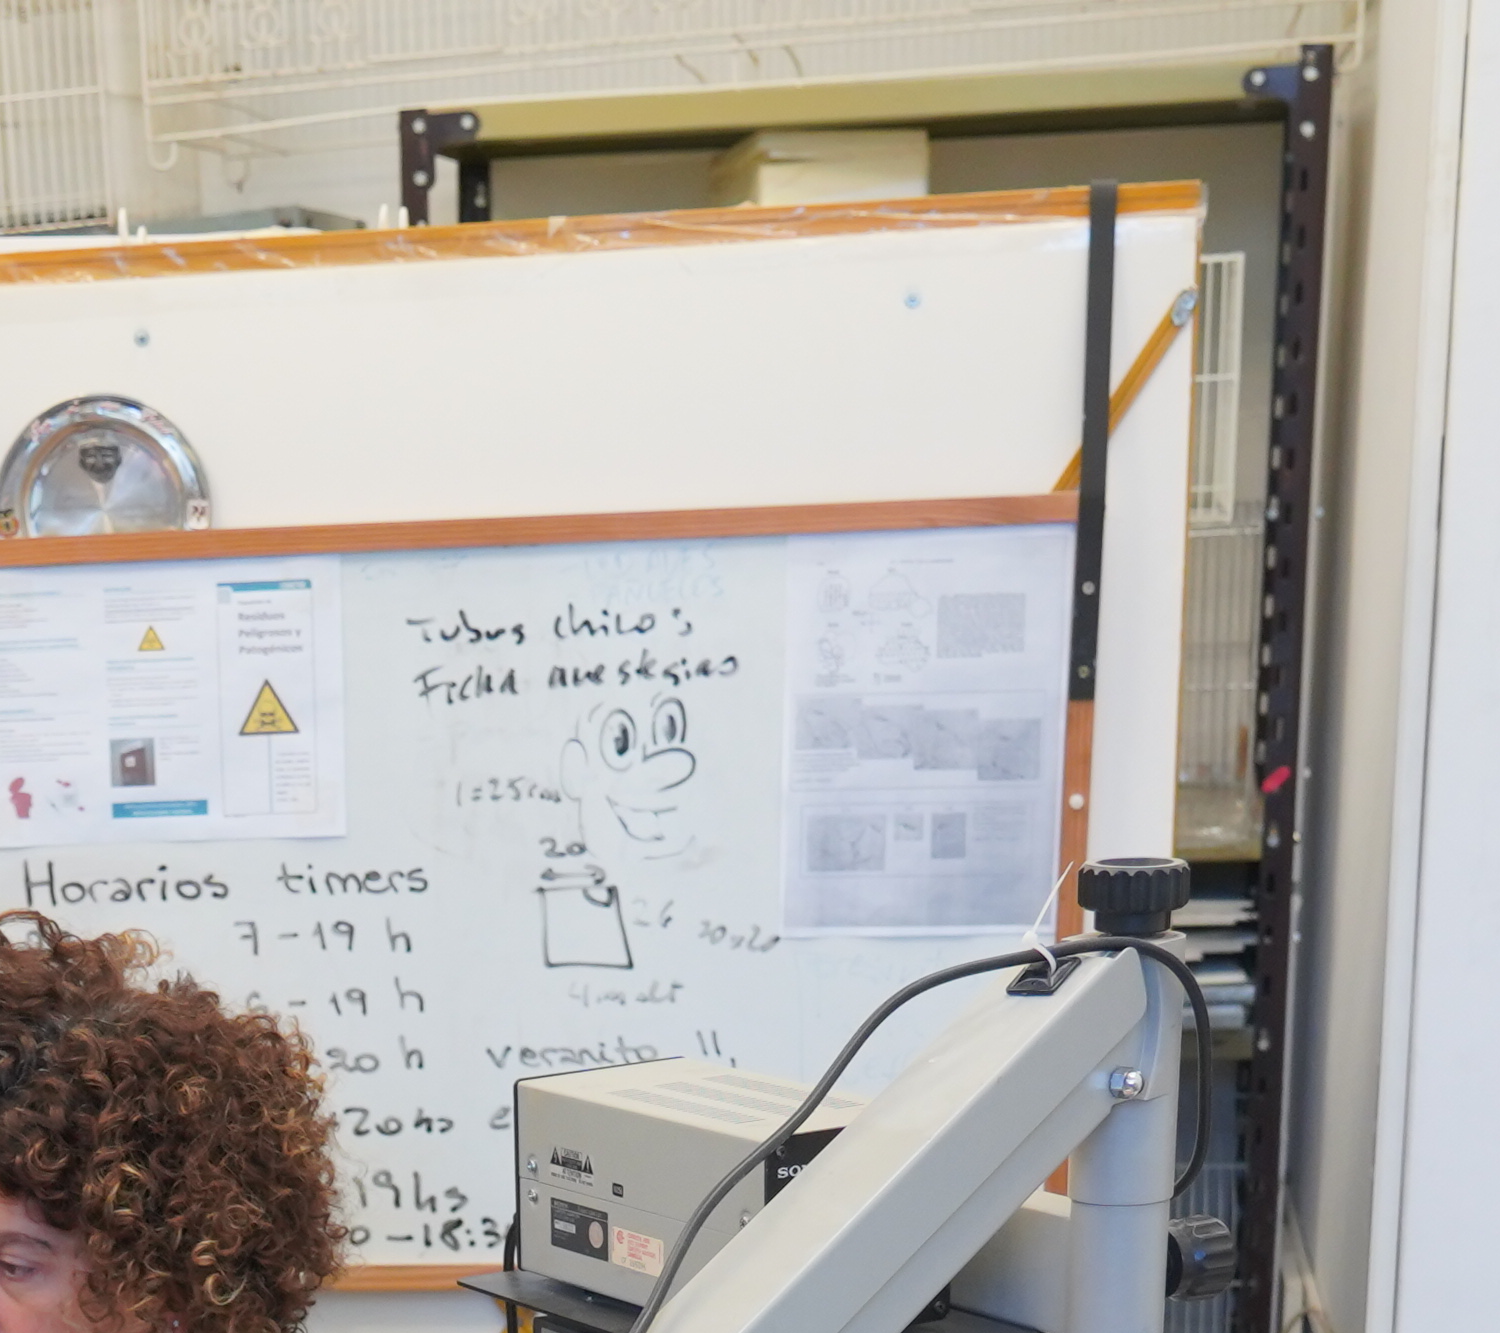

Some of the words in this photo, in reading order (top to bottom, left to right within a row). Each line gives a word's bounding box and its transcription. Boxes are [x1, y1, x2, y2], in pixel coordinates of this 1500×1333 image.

[237, 609, 285, 622] Residuos
[237, 627, 292, 641] Peligrosos
[294, 627, 302, 639] y
[238, 642, 303, 656] Patogénicos
[22, 859, 231, 908] Horarios
[276, 861, 430, 896] timers
[384, 916, 414, 954] h
[395, 977, 426, 1014] h
[399, 1035, 425, 1069] h
[777, 1165, 808, 1180] SO
